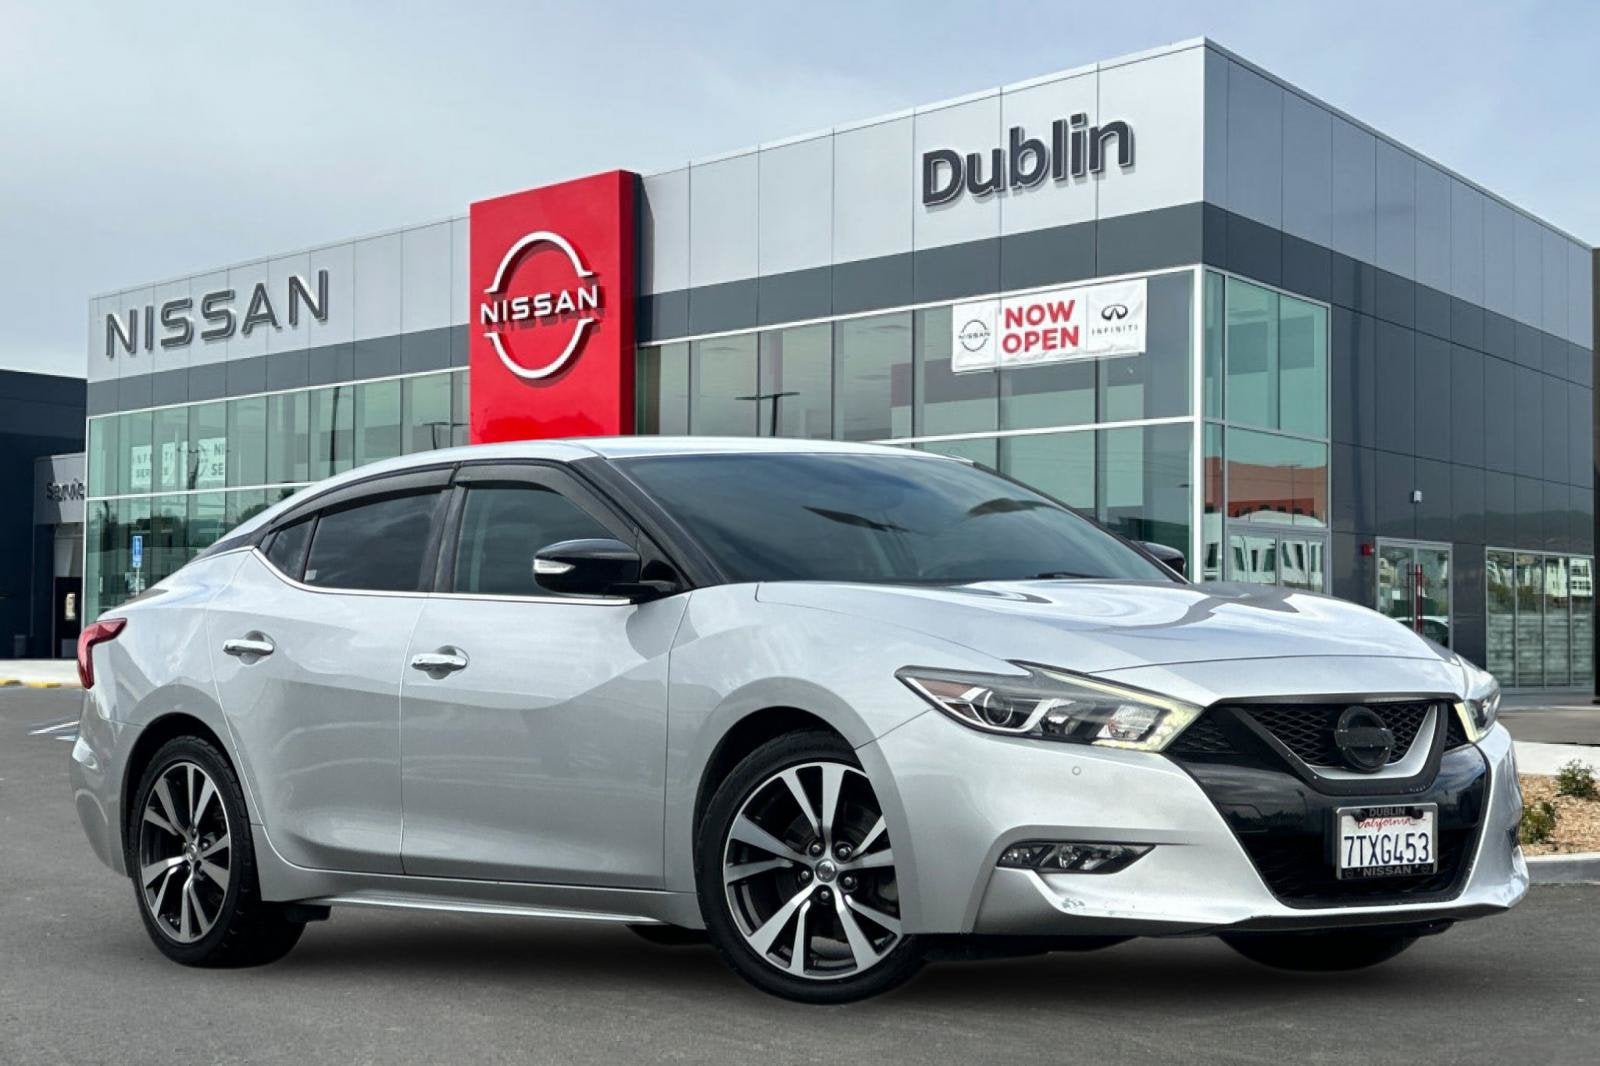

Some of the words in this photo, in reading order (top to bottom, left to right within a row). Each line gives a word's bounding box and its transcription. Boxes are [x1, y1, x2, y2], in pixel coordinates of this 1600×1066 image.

[923, 112, 1134, 206] Dublin
[106, 269, 328, 358] NISSAN
[481, 285, 598, 325] NISSAN
[1004, 299, 1076, 329] NOW
[1002, 325, 1079, 353] OPEN
[1092, 323, 1139, 336] INFINITI
[1369, 806, 1405, 817] DUBLIN
[1344, 832, 1429, 866] 7TXG453
[1363, 865, 1412, 877] NISSAN
